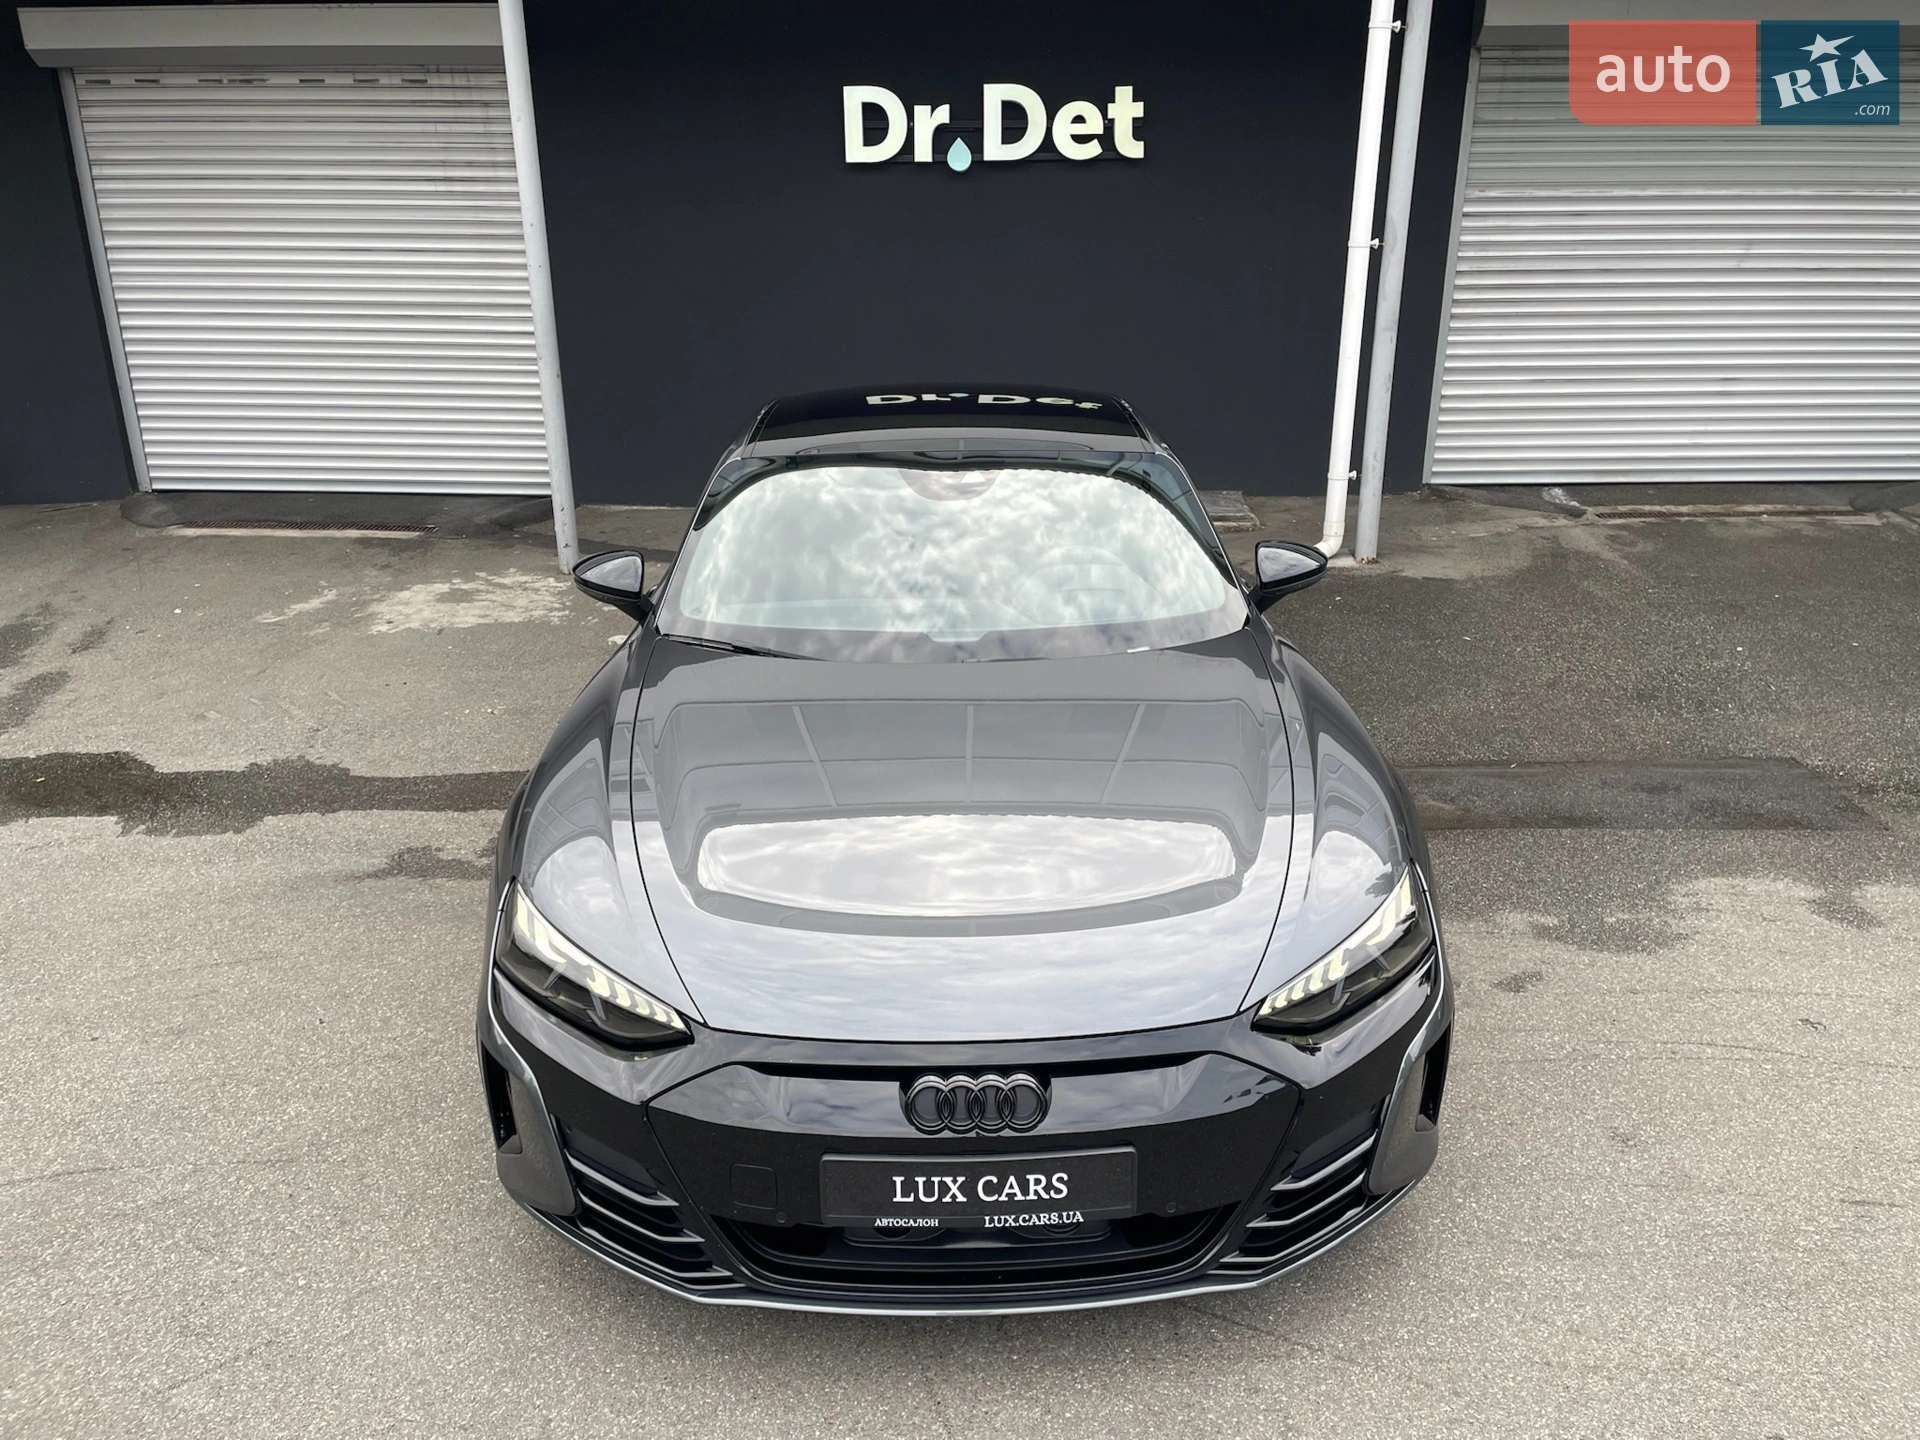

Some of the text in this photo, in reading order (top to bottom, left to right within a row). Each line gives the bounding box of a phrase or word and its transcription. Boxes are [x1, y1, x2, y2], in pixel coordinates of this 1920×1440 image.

[892, 1172, 1069, 1203] LUX CARS
[874, 1217, 939, 1227] АВТОСАЛОН
[984, 1210, 1085, 1228] LUX.CARS.UA
